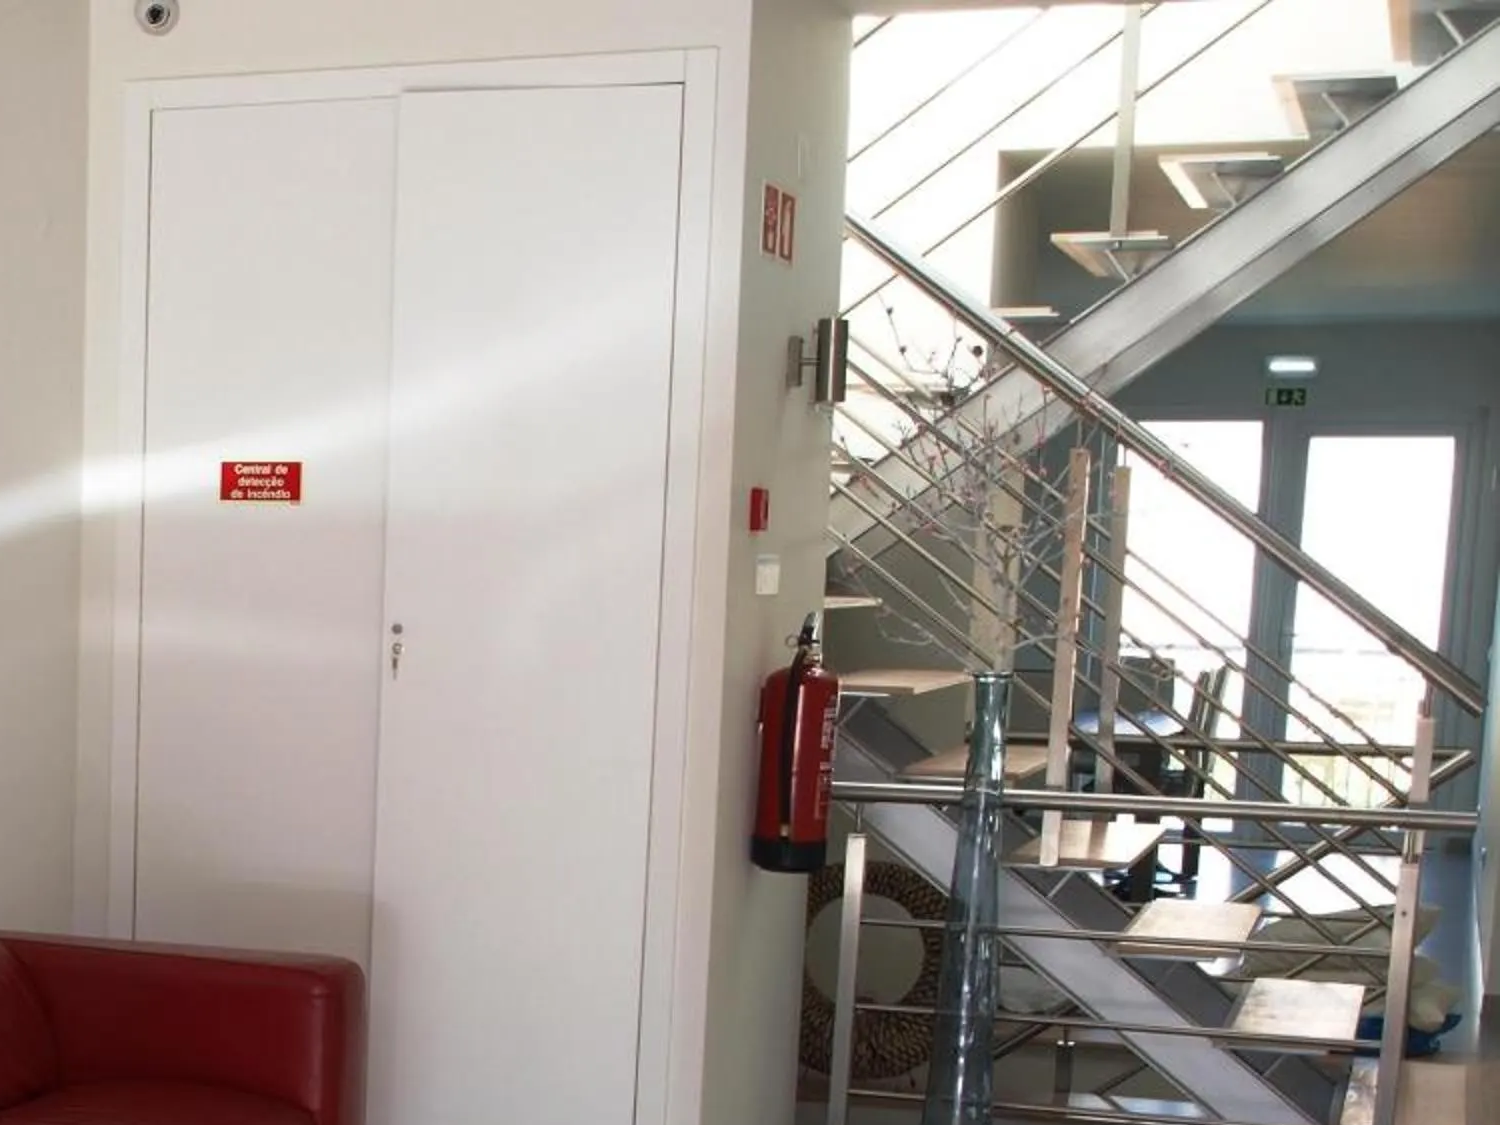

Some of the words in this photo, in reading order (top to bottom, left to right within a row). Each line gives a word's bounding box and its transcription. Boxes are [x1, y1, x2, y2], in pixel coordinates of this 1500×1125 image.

[234, 463, 271, 475] Central
[275, 464, 288, 475] de
[230, 489, 244, 499] de
